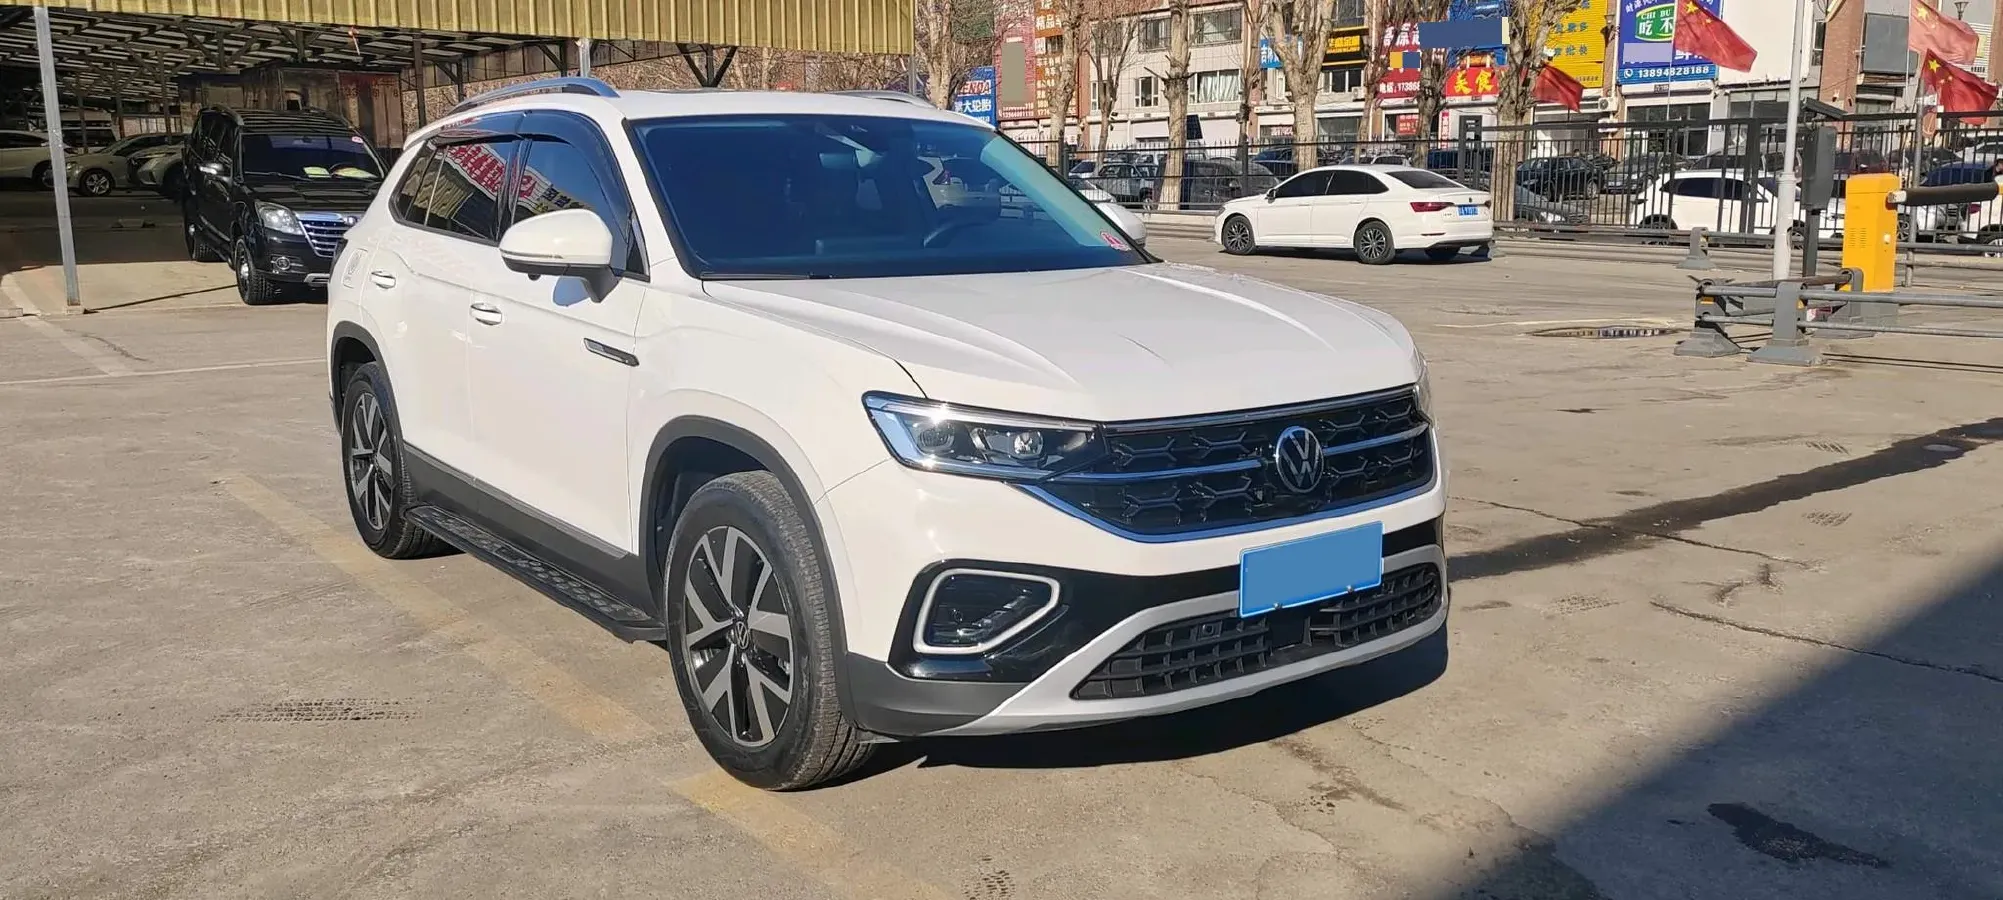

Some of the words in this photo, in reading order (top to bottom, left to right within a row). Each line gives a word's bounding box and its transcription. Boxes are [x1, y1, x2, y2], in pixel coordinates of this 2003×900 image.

[1660, 9, 1671, 17] BU
[1638, 66, 1709, 78] 13894828188
[1454, 69, 1494, 95] 美食
[1278, 427, 1323, 491] VW
